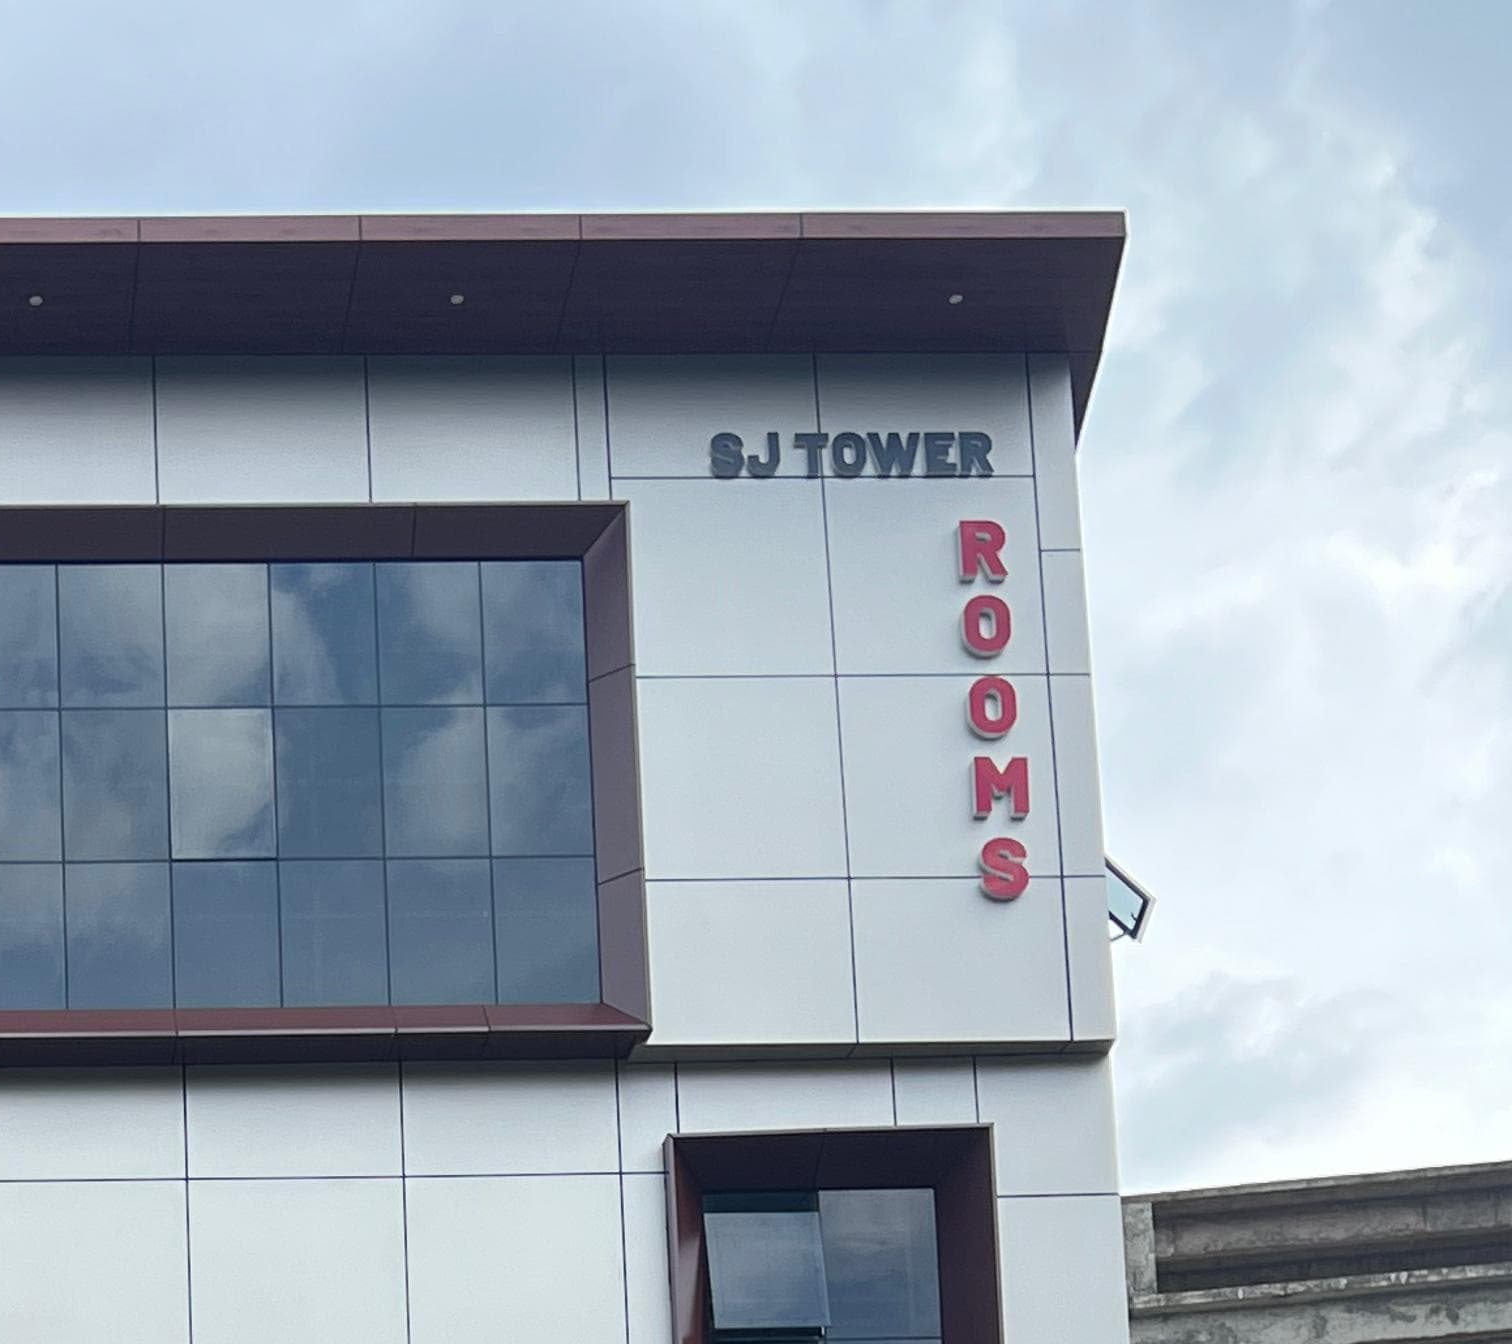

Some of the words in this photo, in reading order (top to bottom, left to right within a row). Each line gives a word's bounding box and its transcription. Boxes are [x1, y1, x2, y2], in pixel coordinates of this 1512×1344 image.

[709, 432, 780, 478] SJ
[794, 432, 994, 477] TOWER
[956, 520, 1030, 902] ROOMS
